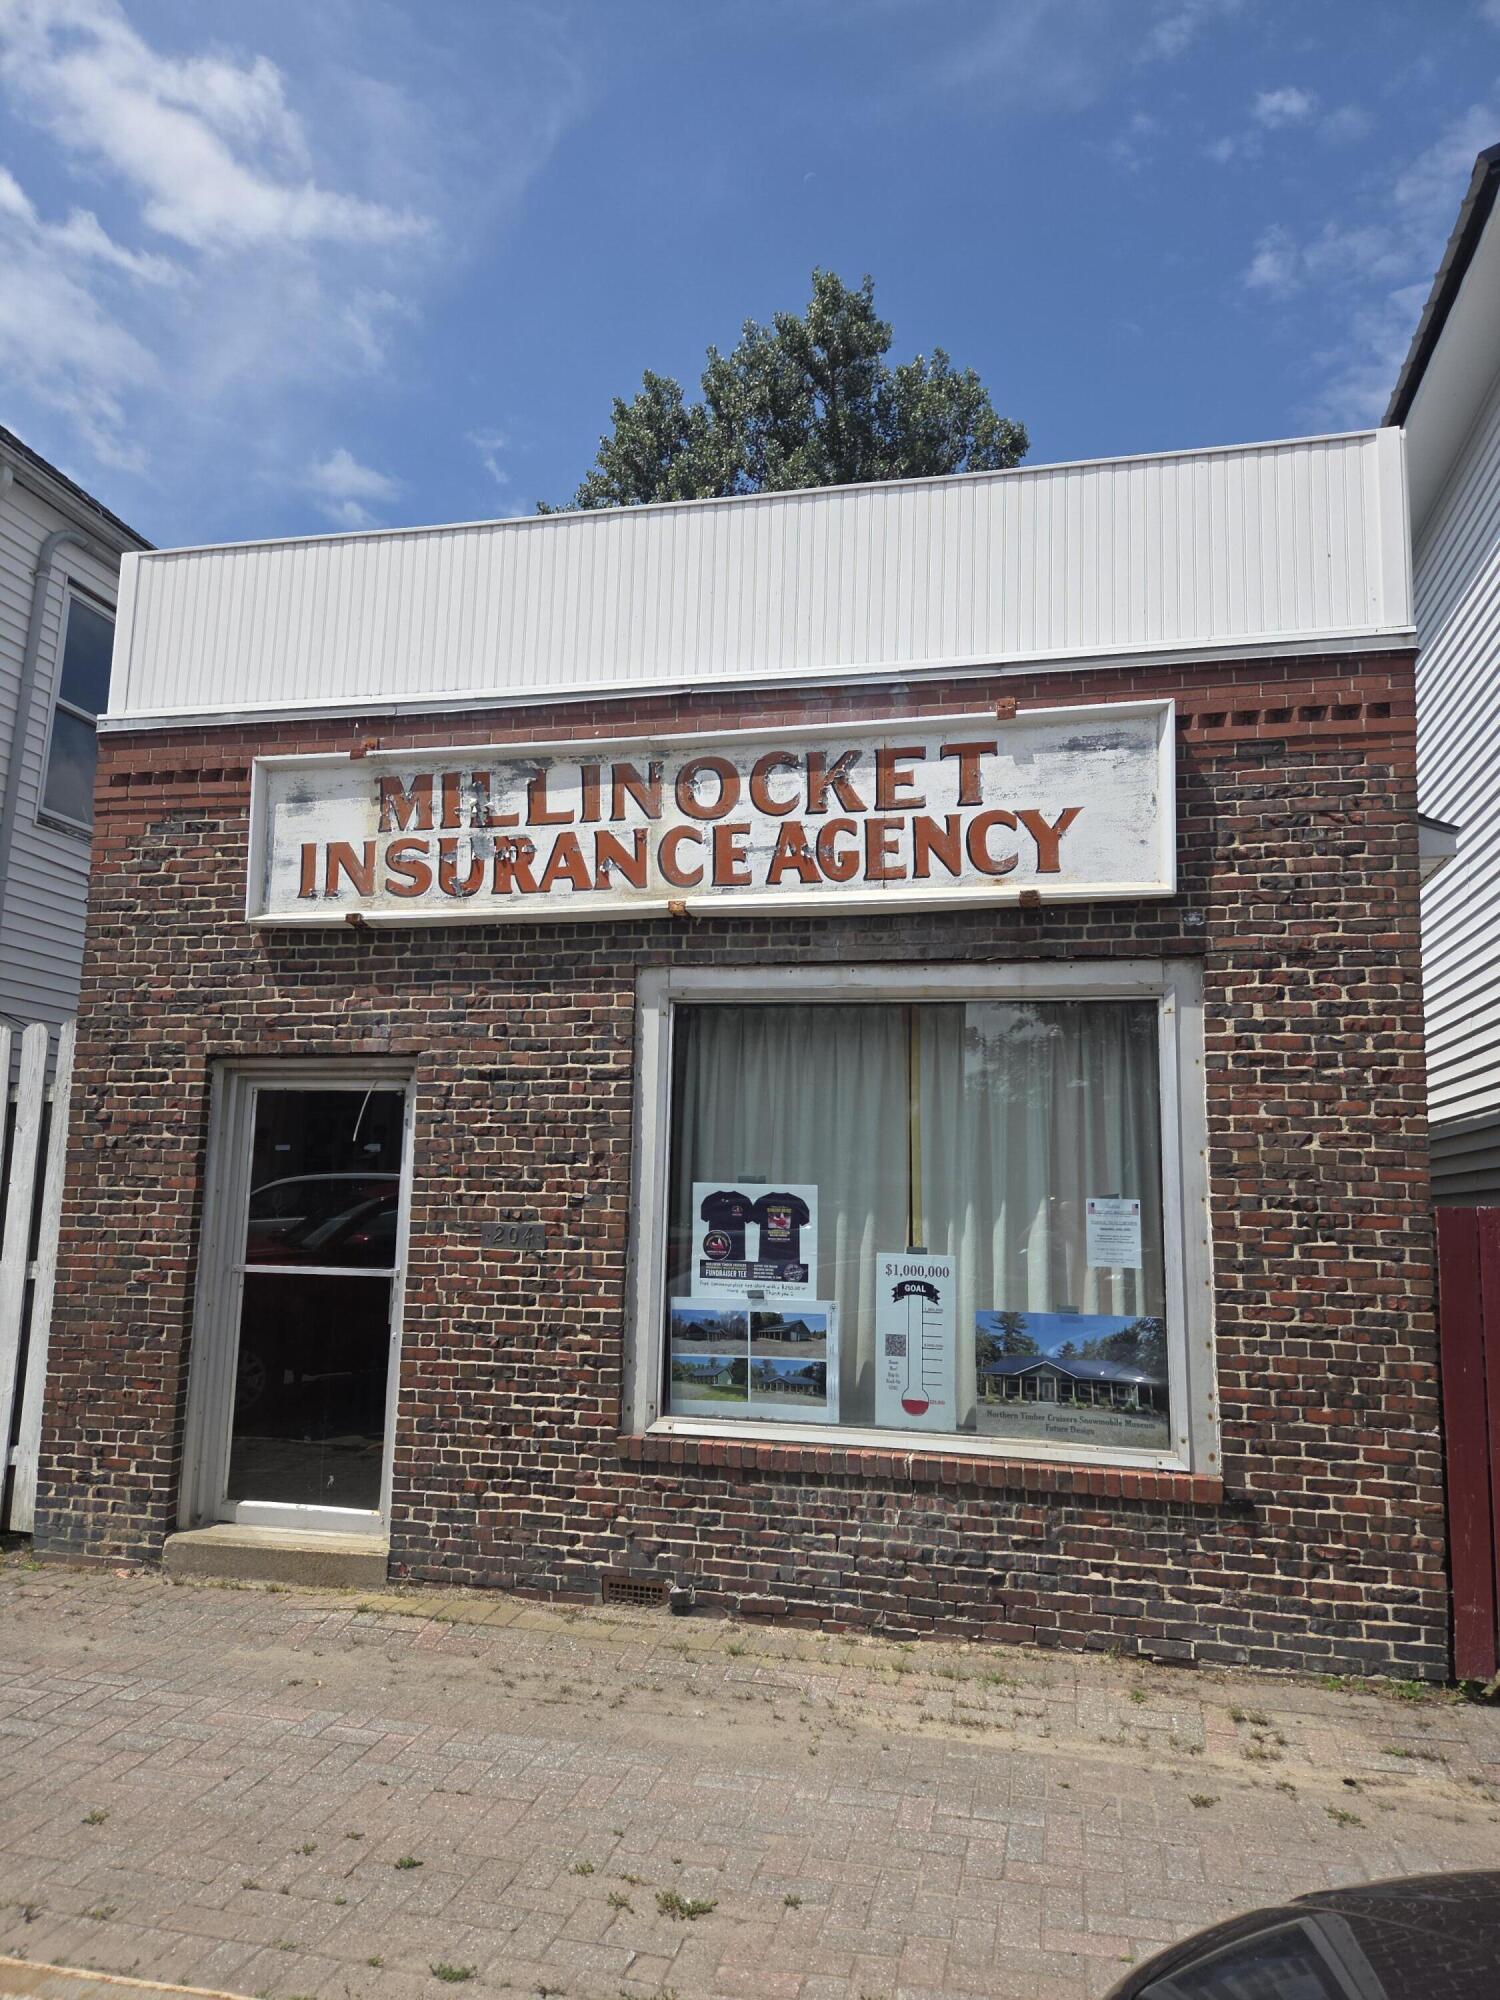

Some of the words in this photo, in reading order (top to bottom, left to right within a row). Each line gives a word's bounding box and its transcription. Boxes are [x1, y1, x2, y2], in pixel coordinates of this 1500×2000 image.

[376, 740, 998, 833] MILLINOCKET
[297, 821, 753, 899] INSURANCE
[765, 805, 1085, 886] AGENCY
[493, 1224, 534, 1248] 204
[705, 1269, 736, 1278] FUNDRAISER
[738, 1270, 747, 1278] TEE
[885, 1263, 950, 1278] $1,000,000
[904, 1283, 927, 1293] GOAL
[986, 1409, 1019, 1420] Northern
[1020, 1411, 1046, 1421] Timber
[1047, 1413, 1078, 1423] Cruisers
[1079, 1415, 1123, 1426] Snowmobile
[1124, 1419, 1156, 1429] Museum
[1045, 1423, 1069, 1433] Future
[1069, 1425, 1095, 1435] Design
